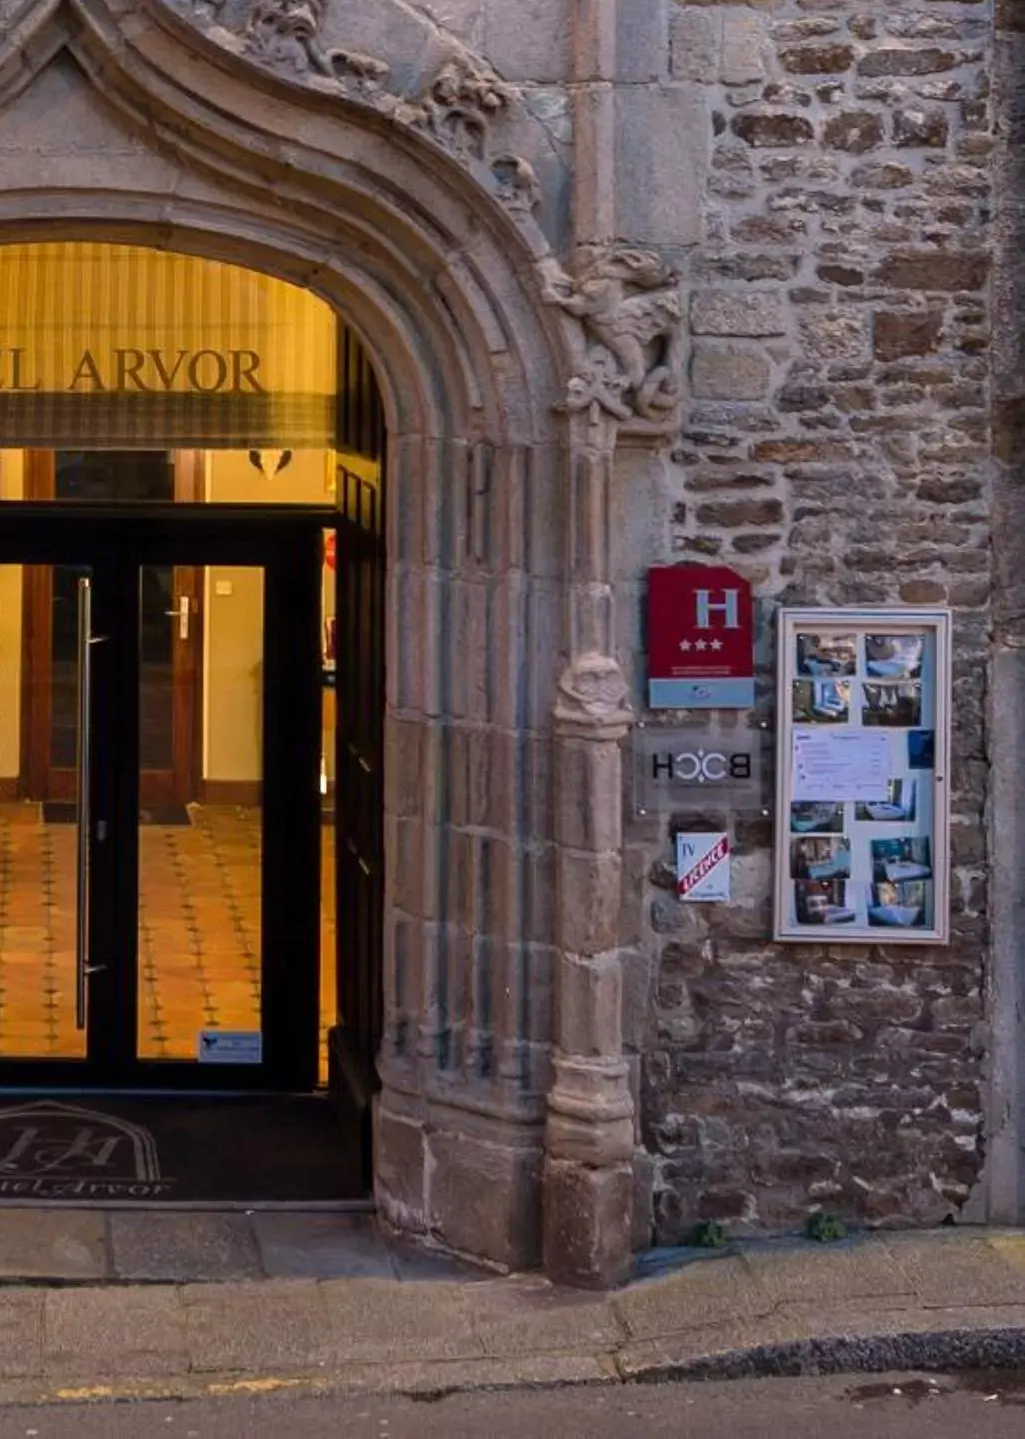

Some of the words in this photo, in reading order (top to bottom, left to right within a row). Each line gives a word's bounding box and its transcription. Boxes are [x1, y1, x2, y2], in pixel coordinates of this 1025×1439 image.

[66, 348, 269, 396] ARVOR
[693, 588, 742, 630] H
[682, 843, 696, 857] IV
